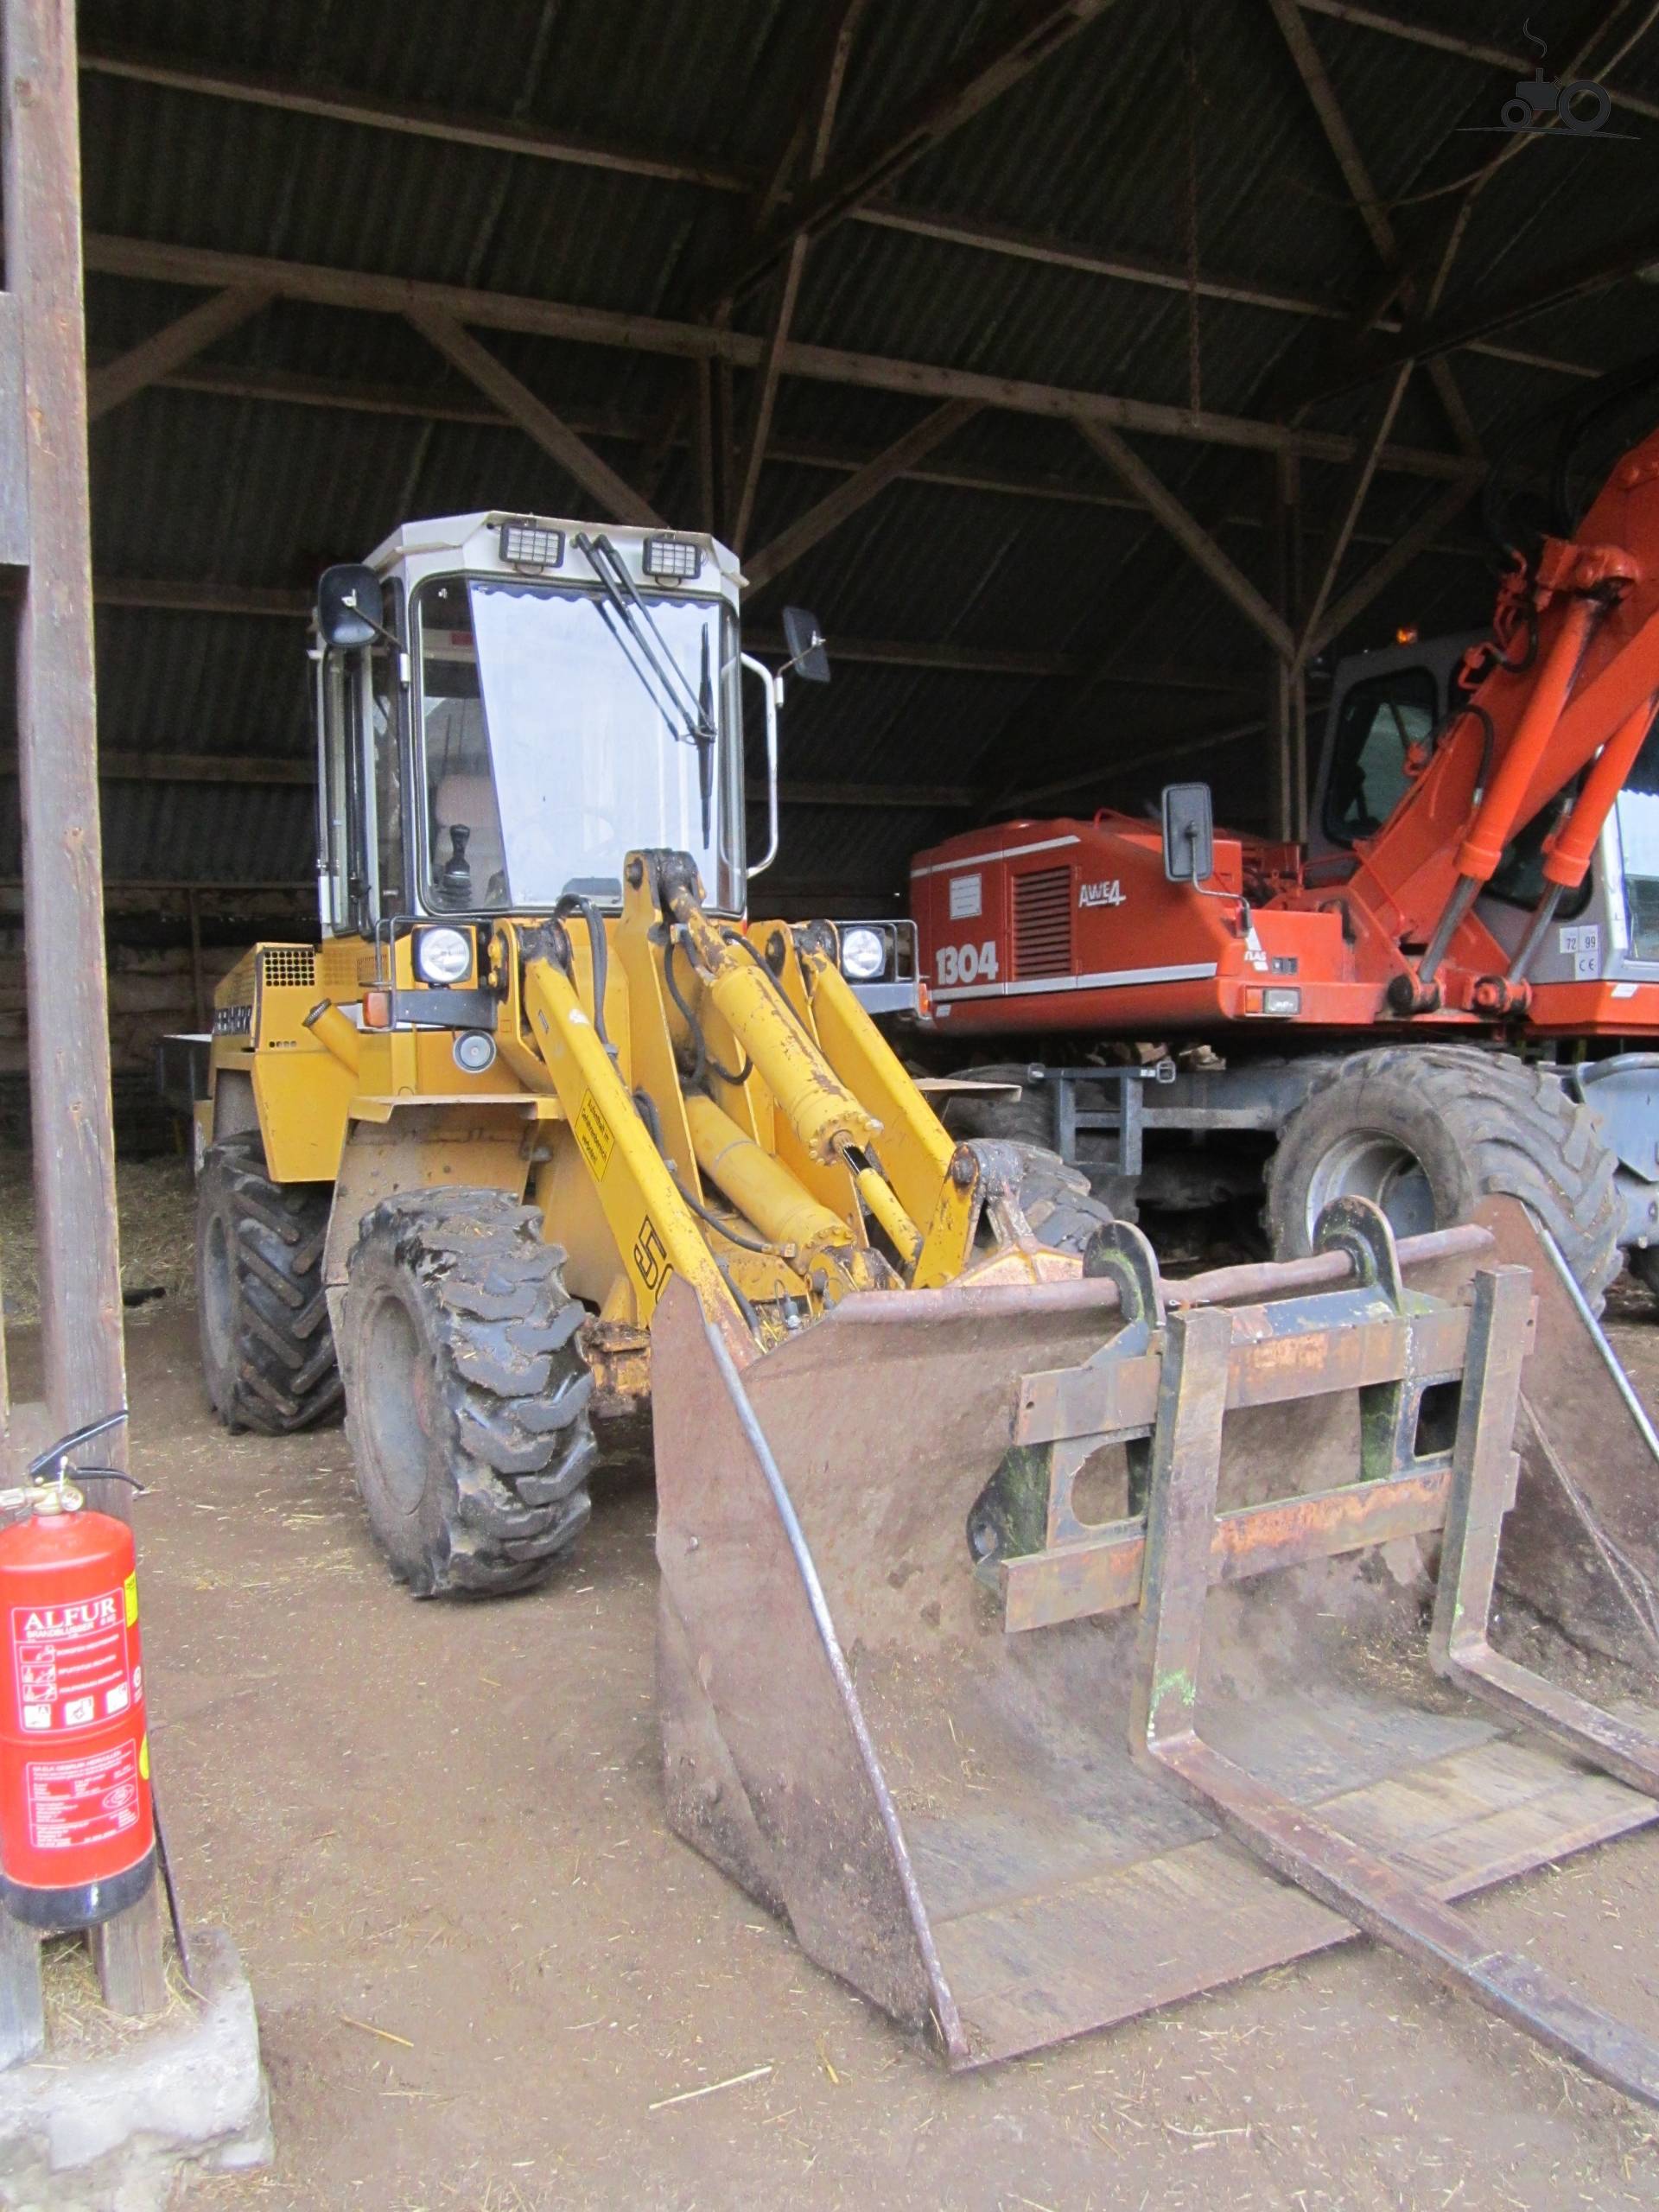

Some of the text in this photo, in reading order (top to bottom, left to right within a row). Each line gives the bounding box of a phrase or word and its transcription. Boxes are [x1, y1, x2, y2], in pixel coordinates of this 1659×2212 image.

[1566, 936, 1596, 950] 72 99
[935, 940, 999, 985] 1304
[1579, 958, 1595, 971] CE
[23, 1597, 117, 1631] ALFUR
